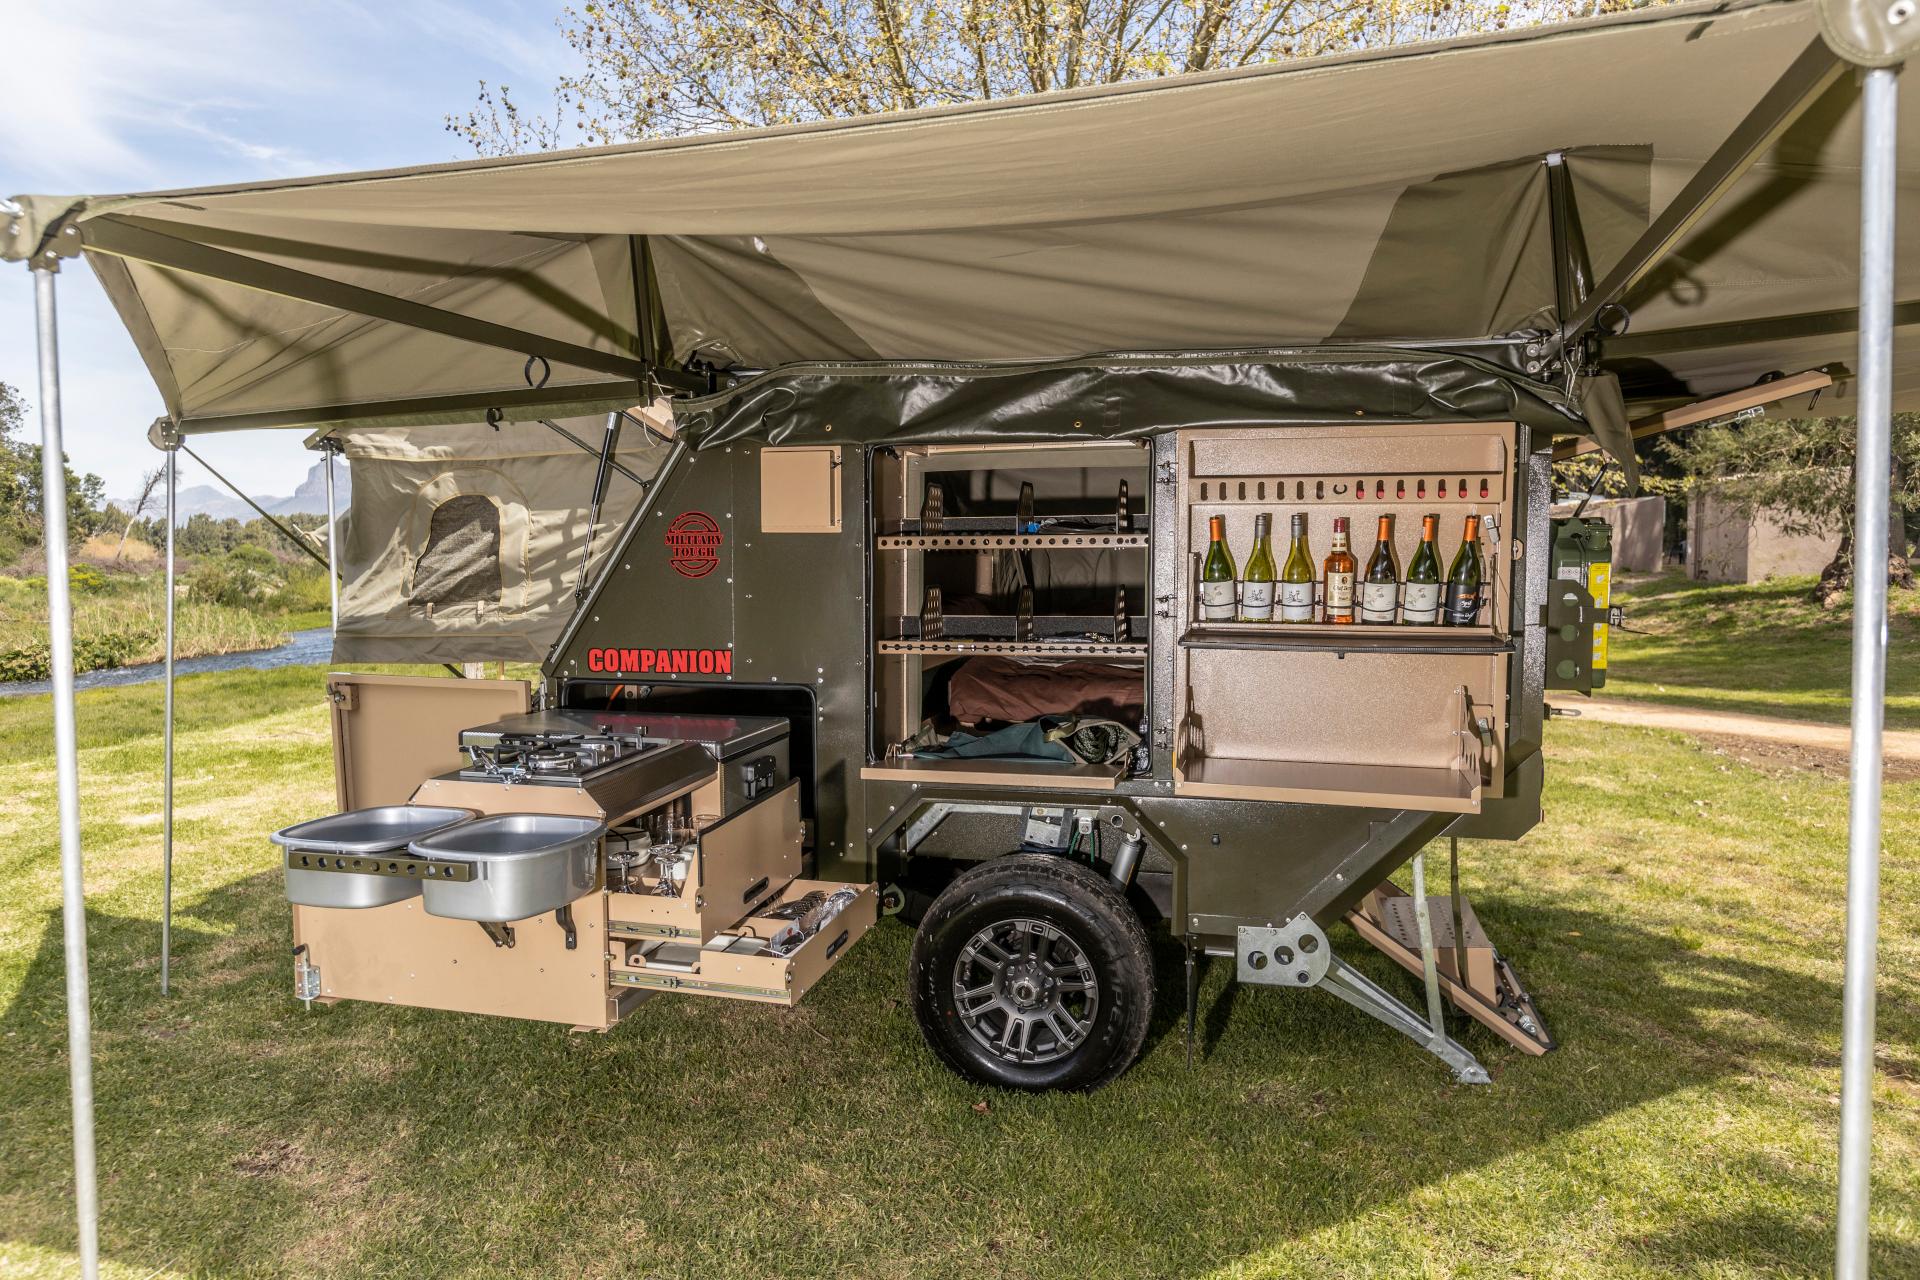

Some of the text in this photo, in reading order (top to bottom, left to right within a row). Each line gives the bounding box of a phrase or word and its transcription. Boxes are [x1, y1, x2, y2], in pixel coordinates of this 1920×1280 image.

[665, 534, 723, 545] MILITARY
[673, 546, 716, 558] TOUGH
[588, 648, 732, 674] COMPANION
